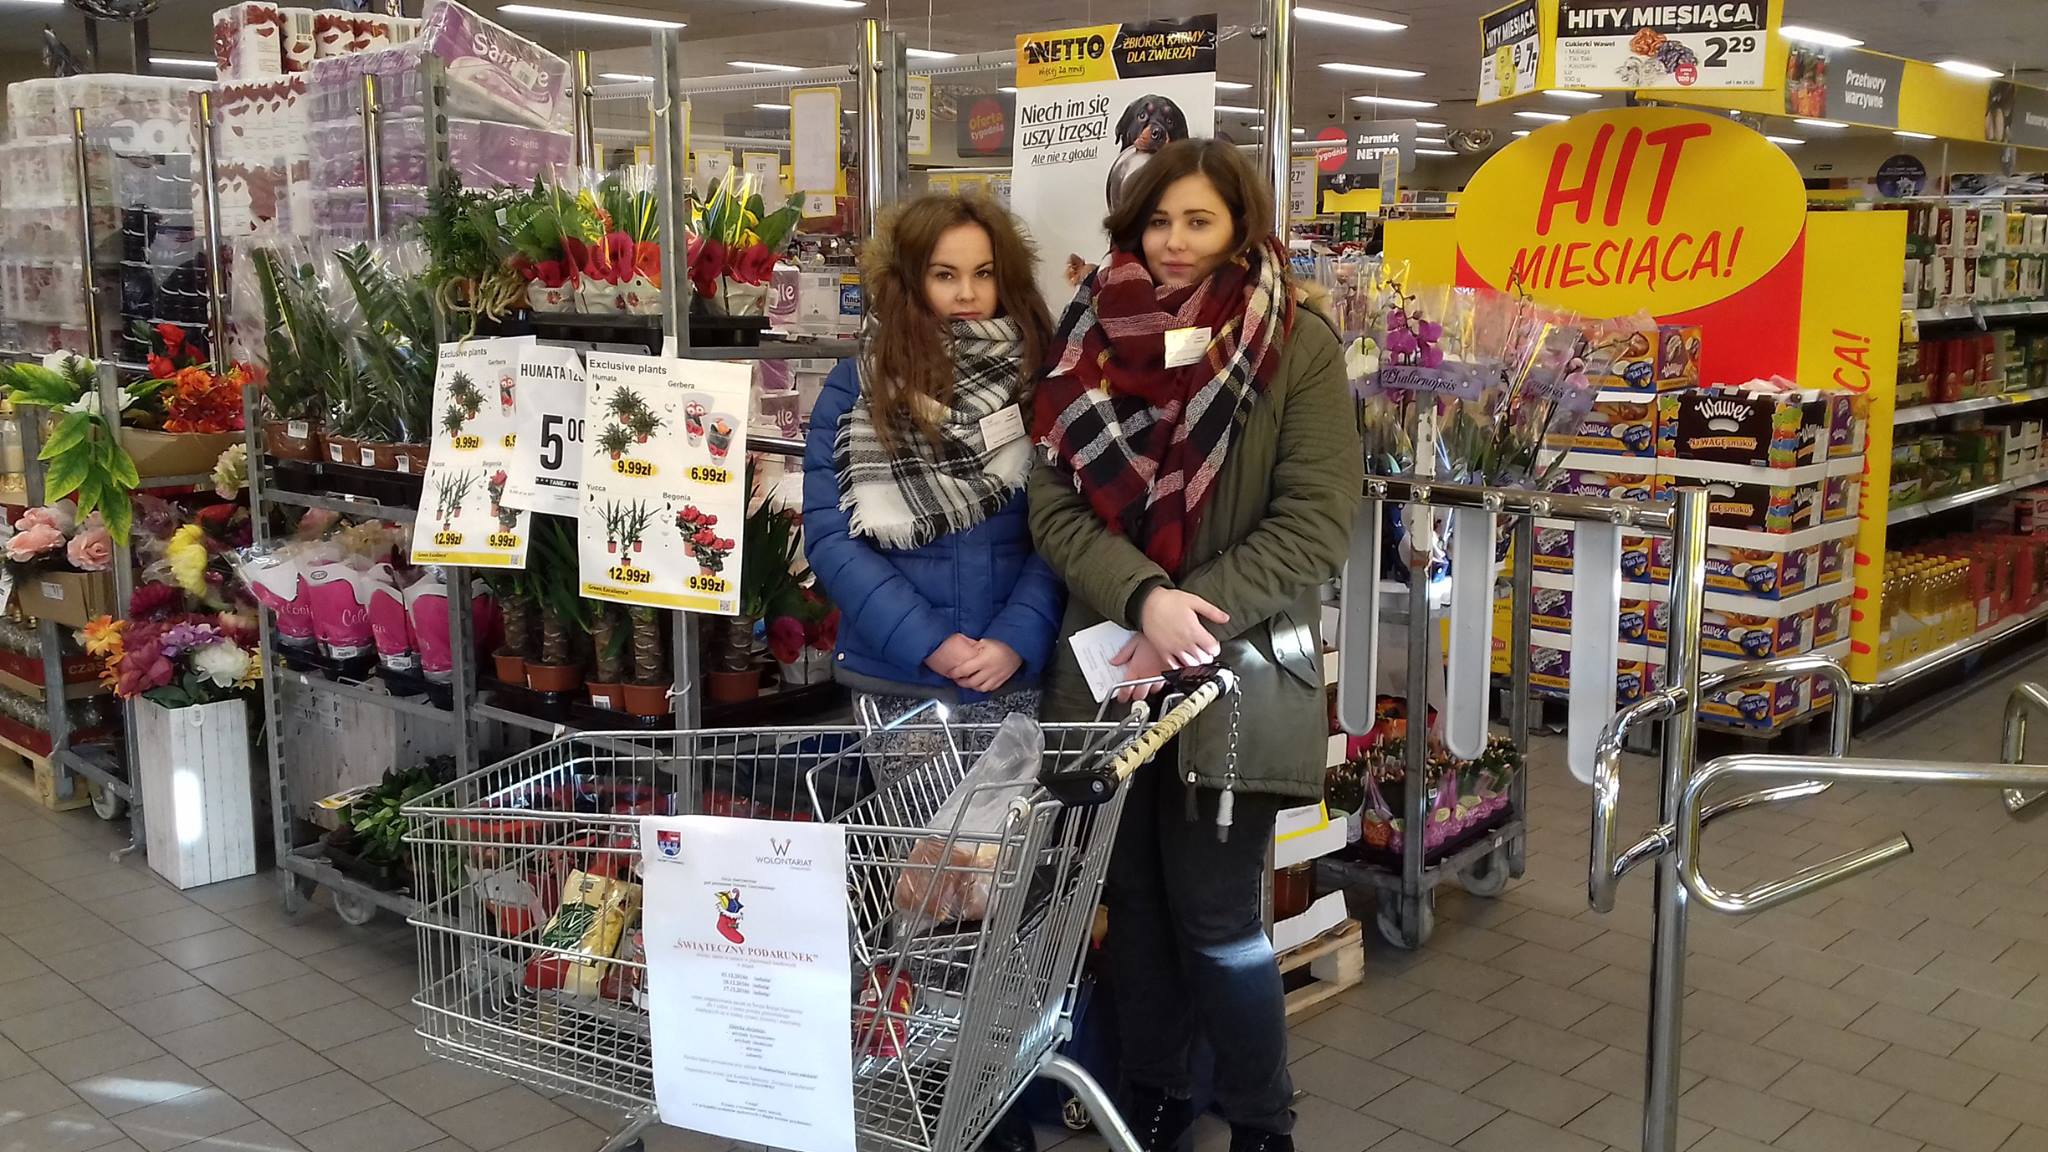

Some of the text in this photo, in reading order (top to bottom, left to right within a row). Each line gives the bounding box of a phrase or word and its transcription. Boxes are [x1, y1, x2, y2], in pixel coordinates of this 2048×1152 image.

[1567, 2, 1754, 29] HITY MIESIĄCA
[1166, 30, 1205, 45] KARMY
[1486, 8, 1536, 50] HITY MIESIĄCA
[1024, 34, 1105, 64] NETTO
[1126, 45, 1198, 64] DLA ZWIERZĄT
[1846, 69, 1887, 94] Przetwory
[1844, 90, 1884, 109] warzywne
[1020, 94, 1110, 126] Niech im się
[969, 112, 1004, 130] Oferta
[971, 124, 1005, 141] tygodnia
[1022, 117, 1108, 150] uszy trzęsą!
[1358, 132, 1400, 146] Jarmark
[1031, 146, 1098, 166] Ale nie z głodu!
[1536, 122, 1712, 237] HIT
[1505, 226, 1745, 293] MIESIĄCA!
[440, 348, 488, 360] Exclusive plants
[520, 363, 566, 381] HUMATA
[589, 359, 667, 375] Exclusive plants
[592, 374, 618, 382] Humata
[667, 380, 695, 390] Gerbera
[1694, 398, 1752, 423] Wawel
[1578, 423, 1608, 438] Wawel
[455, 437, 479, 449] 9.99zł
[617, 460, 652, 476] 9.99zł
[691, 467, 727, 483] 6.99zł
[586, 483, 607, 493] Yucca
[662, 492, 691, 502] Begonia
[434, 533, 462, 545] 12.99zł
[489, 534, 517, 547] 9.99zł
[608, 567, 650, 584] 12.99zł
[689, 576, 725, 593] 9.99zł
[755, 857, 812, 868] WOLONTARIAT
